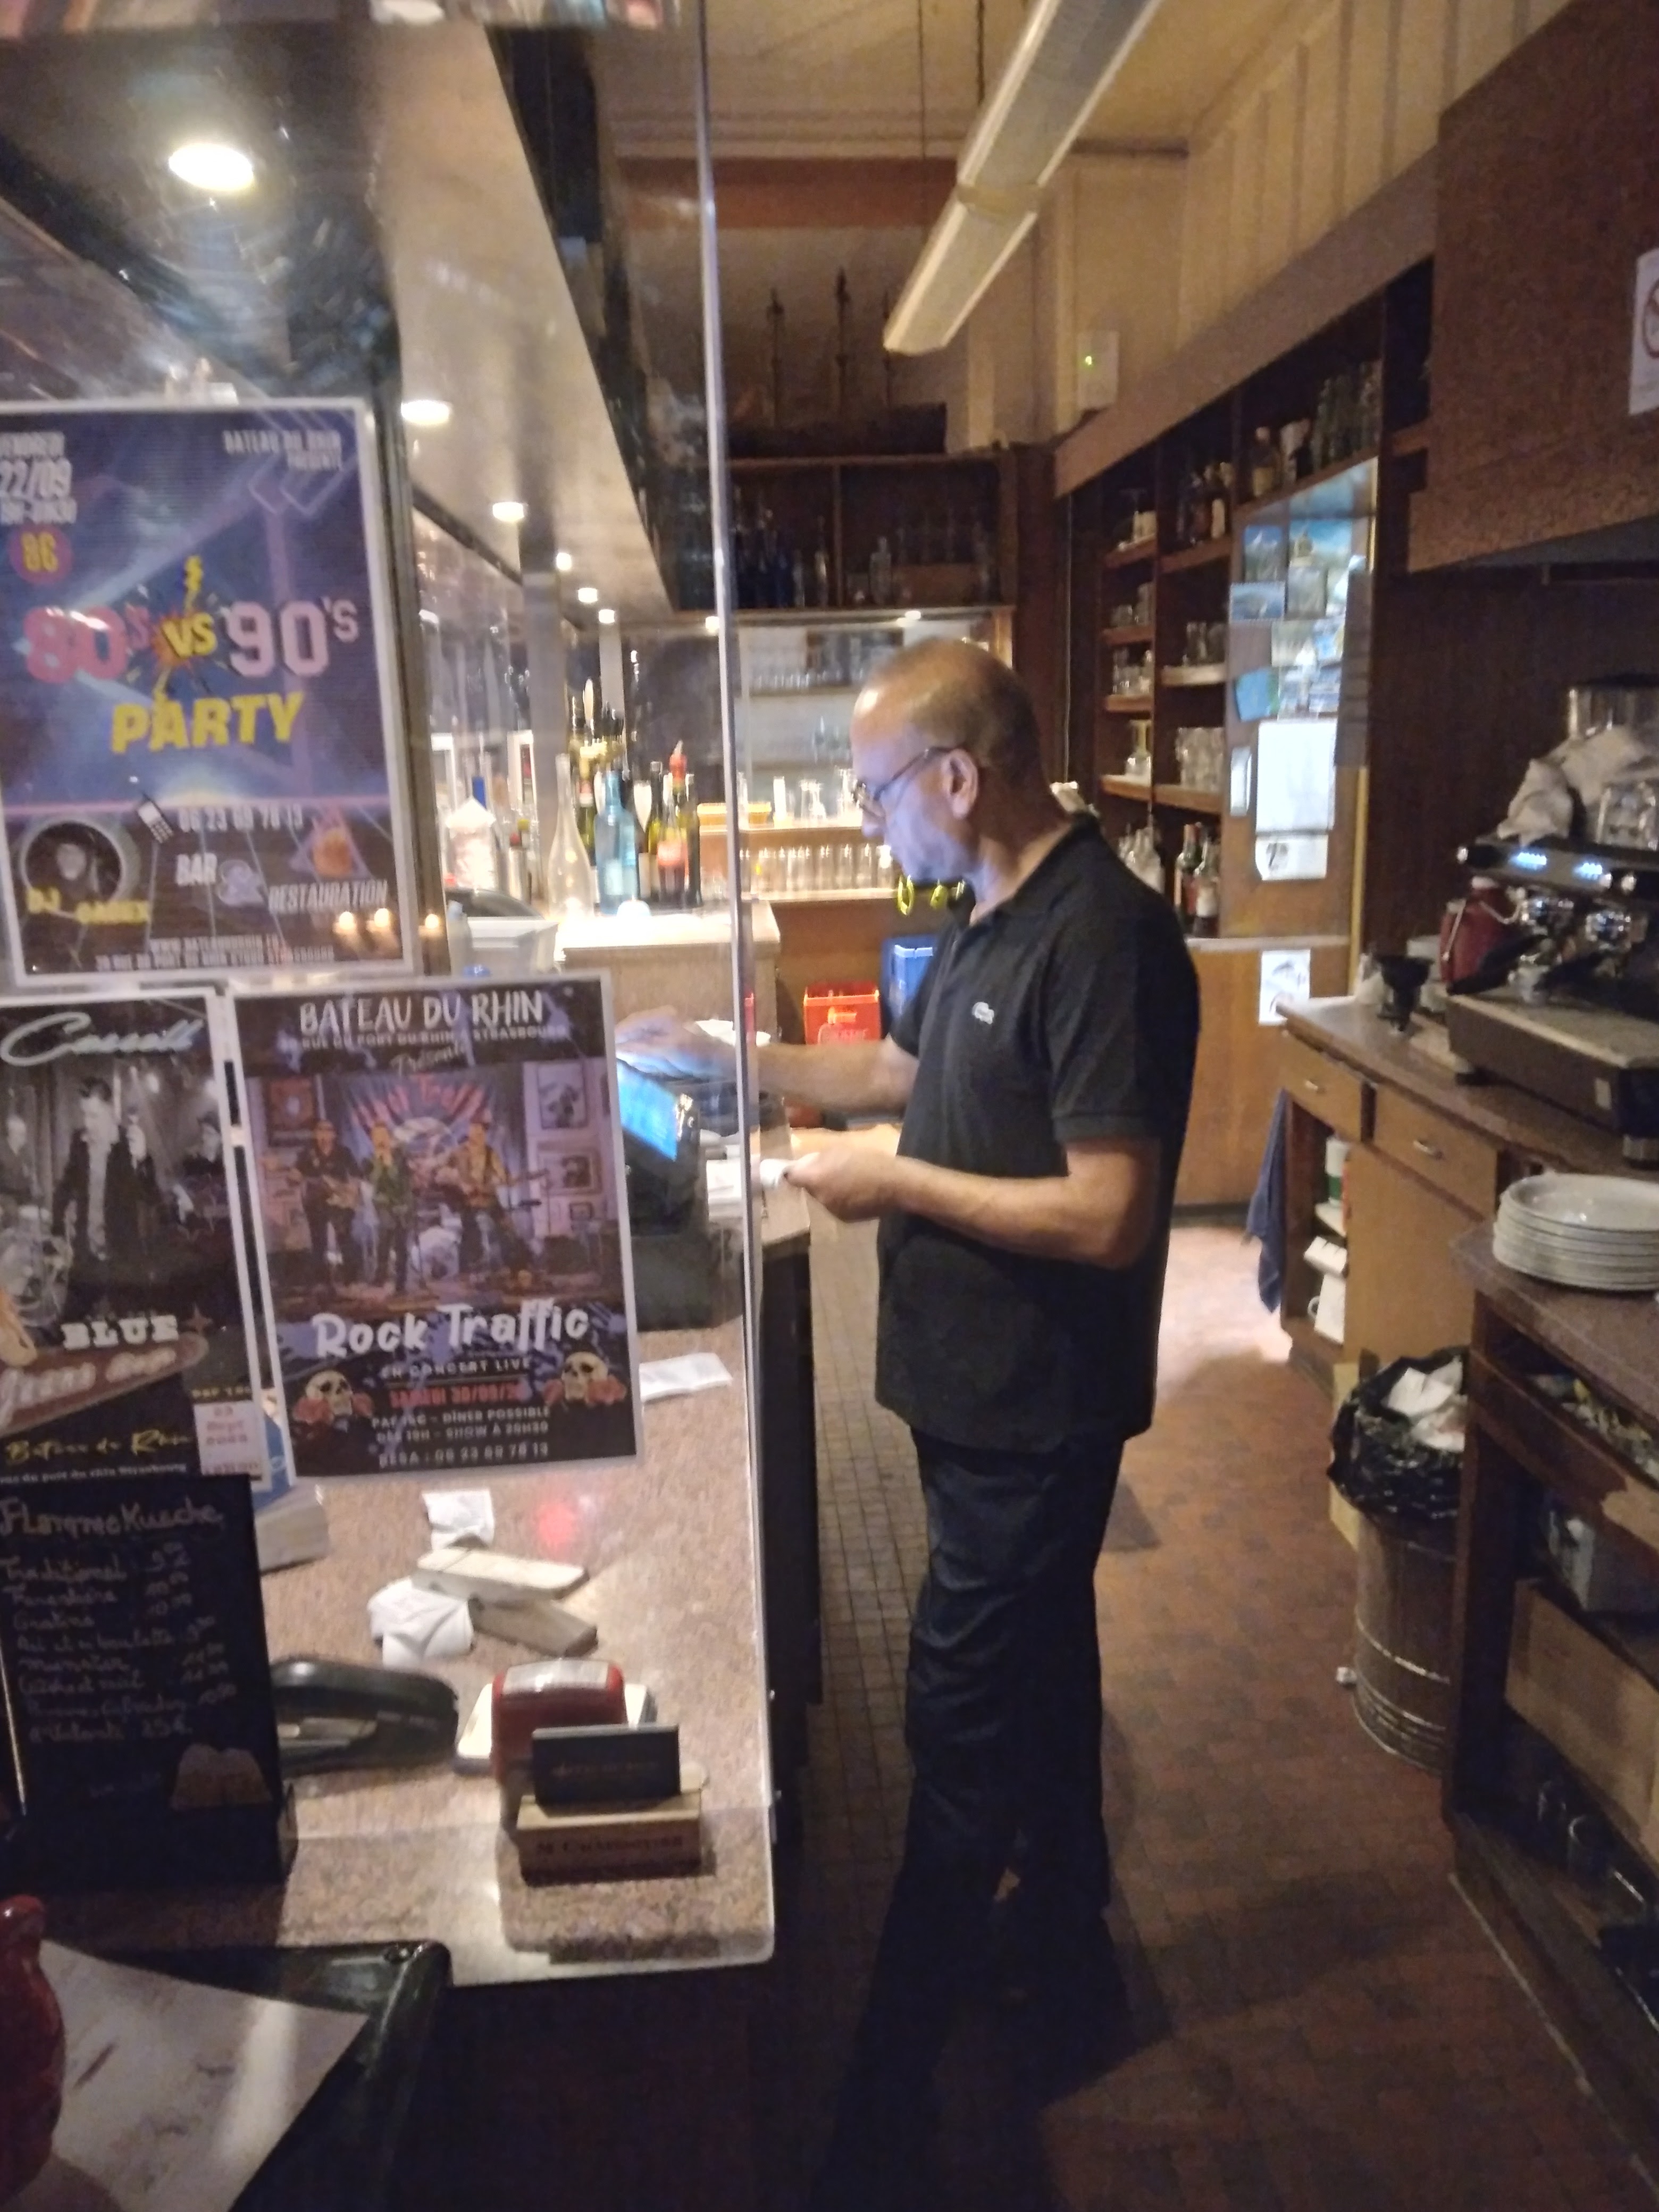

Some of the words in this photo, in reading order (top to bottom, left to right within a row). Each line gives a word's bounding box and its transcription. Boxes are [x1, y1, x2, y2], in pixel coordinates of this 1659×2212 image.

[111, 691, 305, 753] PARTY
[175, 853, 217, 886] BAR
[268, 879, 388, 914] RESTAURATION
[299, 995, 413, 1034] BATEAU
[422, 994, 461, 1024] DU
[471, 989, 544, 1028] RHIN
[60, 1314, 179, 1351] BLUE
[312, 1312, 428, 1359] Rock
[435, 1298, 590, 1352] Traffic
[409, 1360, 488, 1377] CONCERT
[495, 1357, 531, 1372] LIVE
[487, 1405, 550, 1420] POSSIBLE
